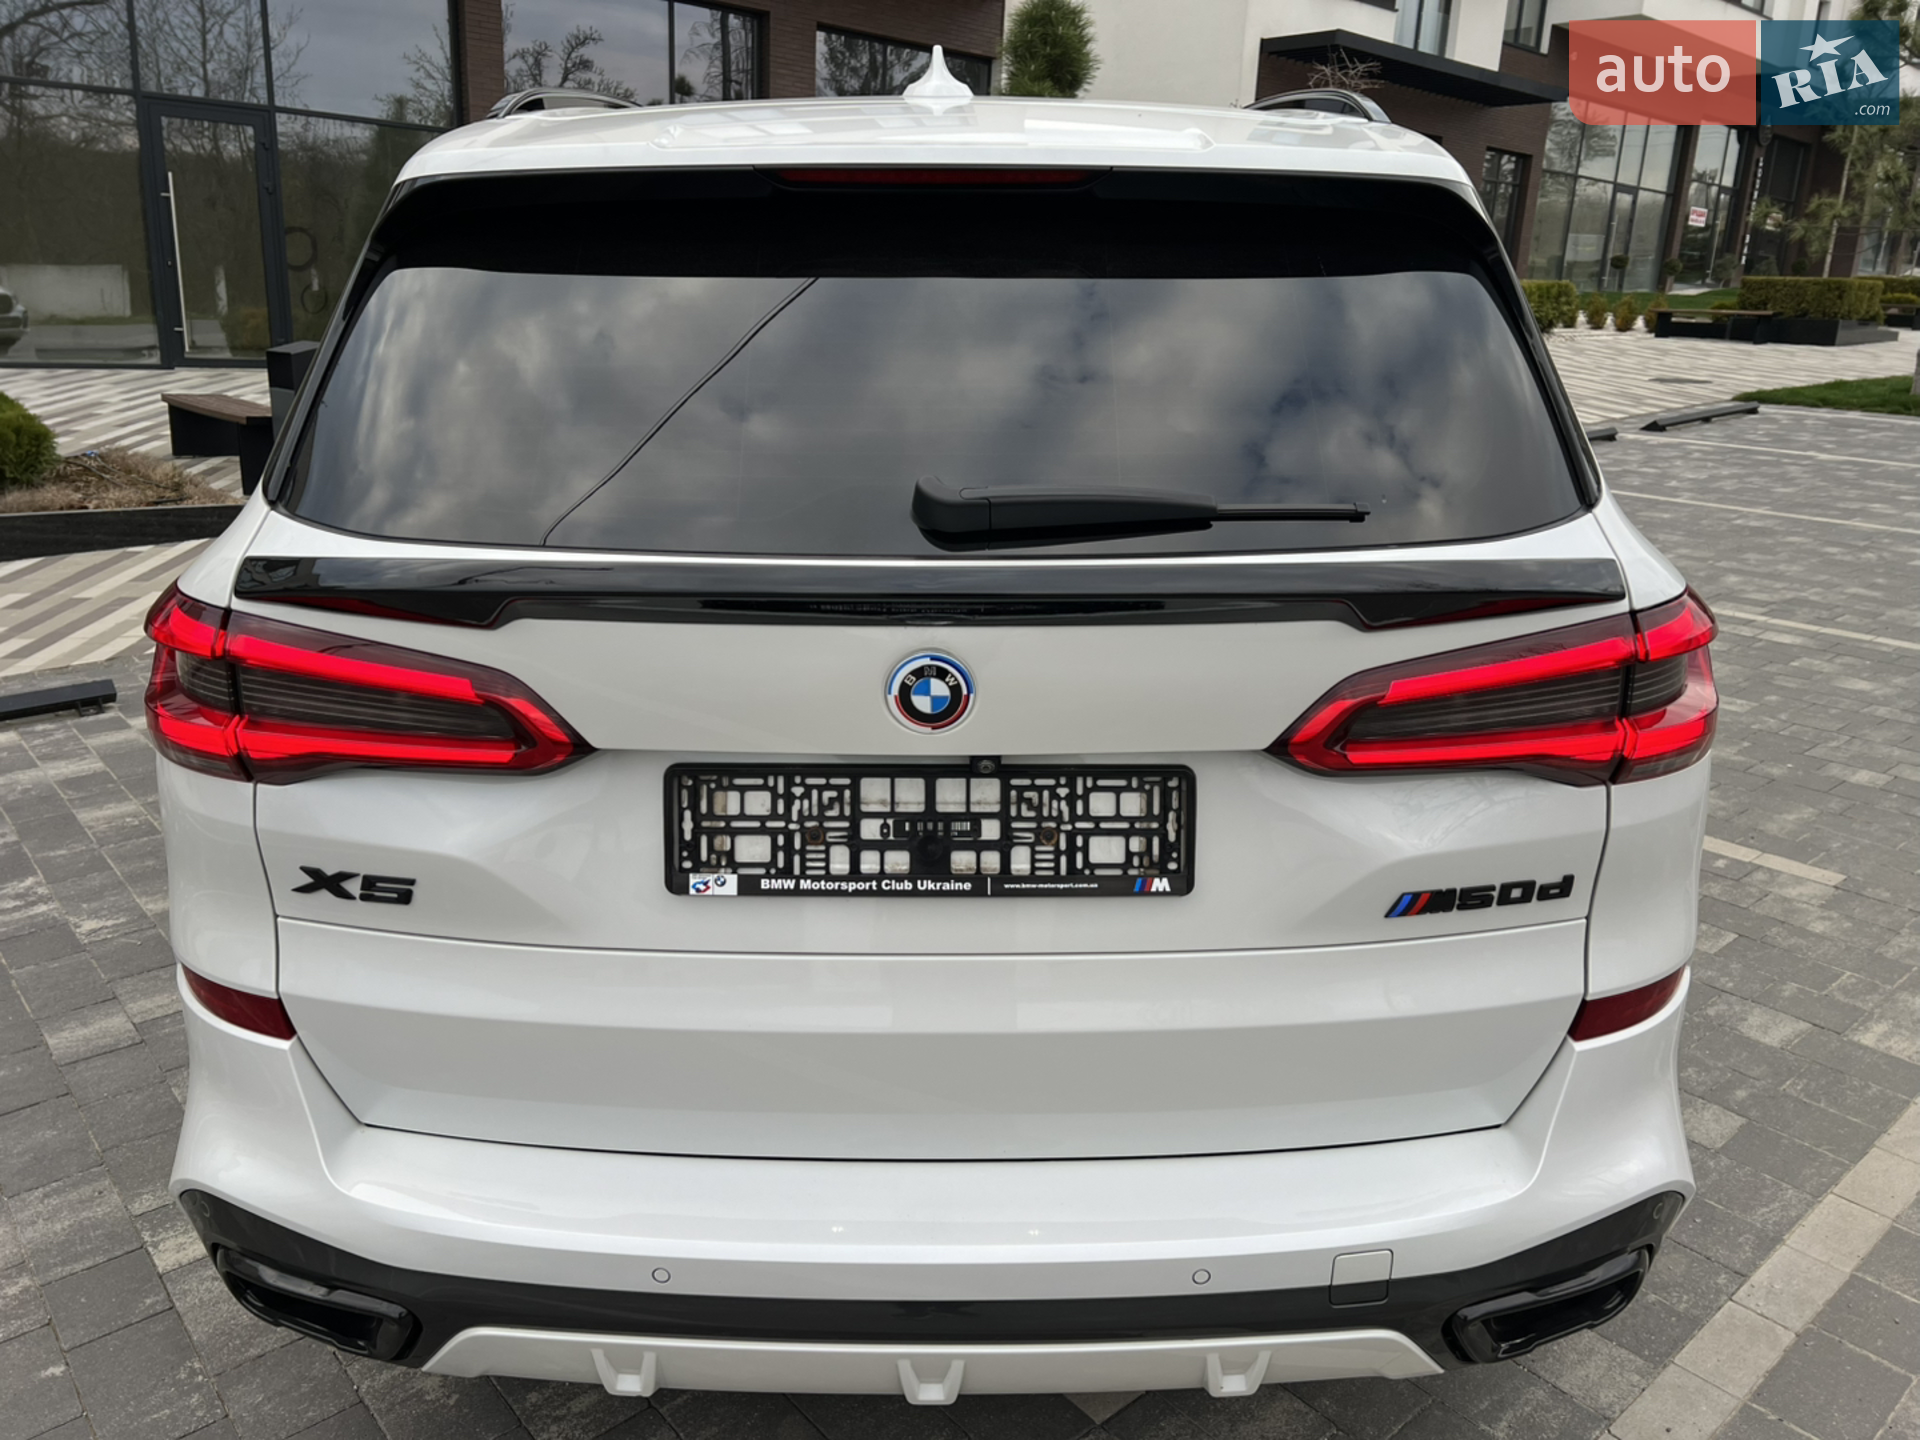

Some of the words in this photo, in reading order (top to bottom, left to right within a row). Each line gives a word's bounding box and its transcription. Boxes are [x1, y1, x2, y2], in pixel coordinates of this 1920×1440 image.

[903, 666, 958, 687] BMW
[291, 865, 417, 905] X5
[760, 878, 796, 890] BMW
[799, 878, 878, 893] Motorsport
[881, 879, 913, 891] Club
[916, 879, 972, 891] Ukraine
[1412, 874, 1575, 915] M50d
